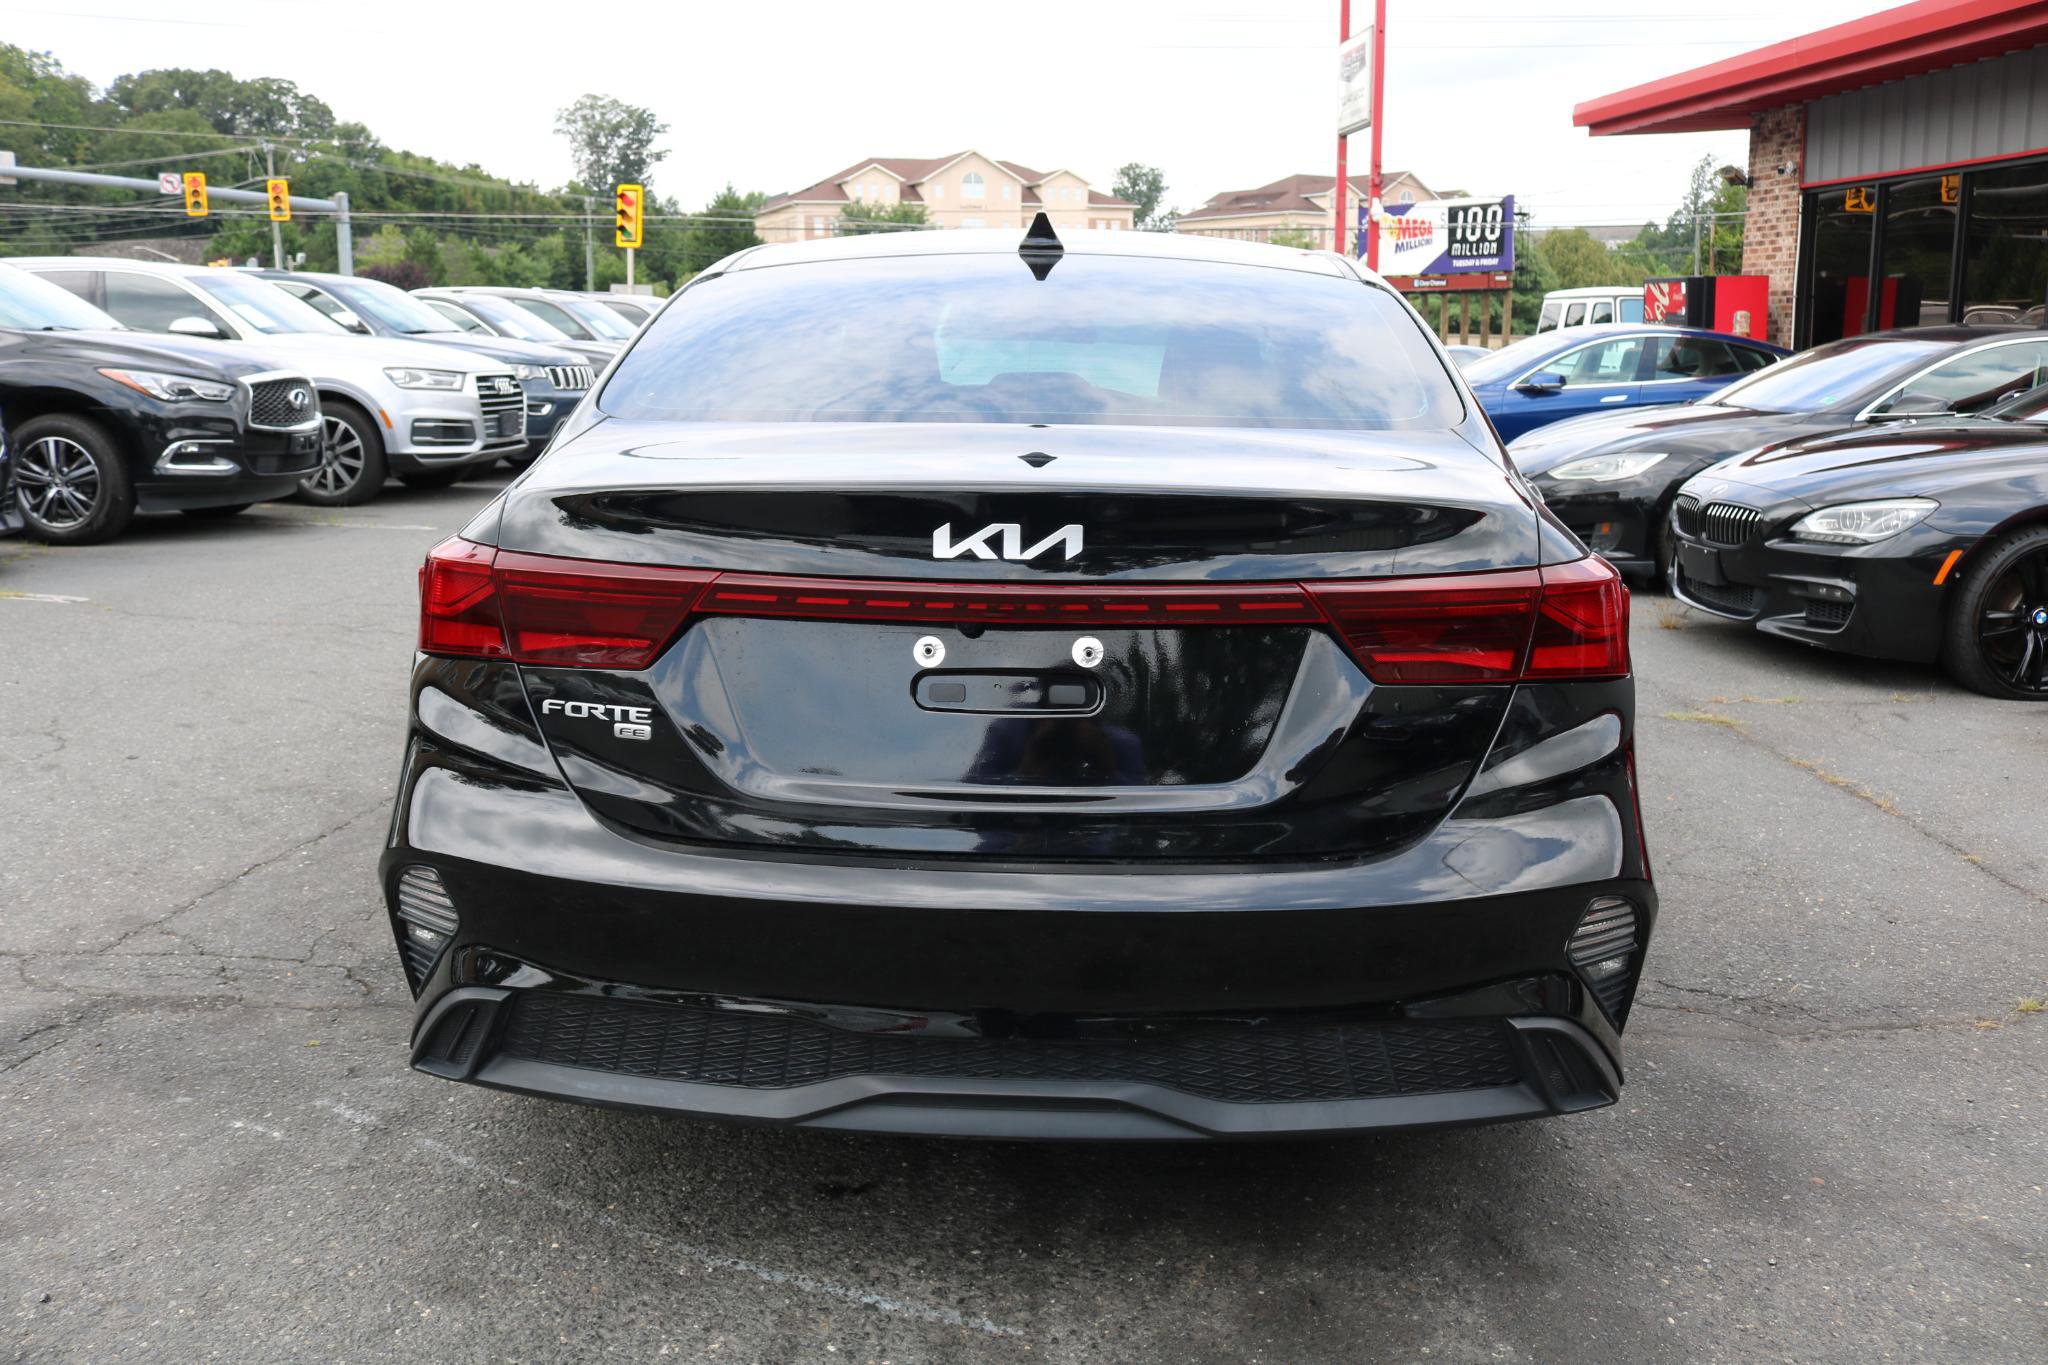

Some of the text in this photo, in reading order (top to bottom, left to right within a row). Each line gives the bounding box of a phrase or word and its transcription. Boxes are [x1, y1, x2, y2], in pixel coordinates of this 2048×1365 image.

[1396, 216, 1433, 241] MEGA
[1456, 204, 1502, 242] 100
[1451, 242, 1498, 256] MILLION
[933, 522, 1083, 560] KIA
[542, 699, 652, 723] FORTE
[618, 726, 647, 738] FE
